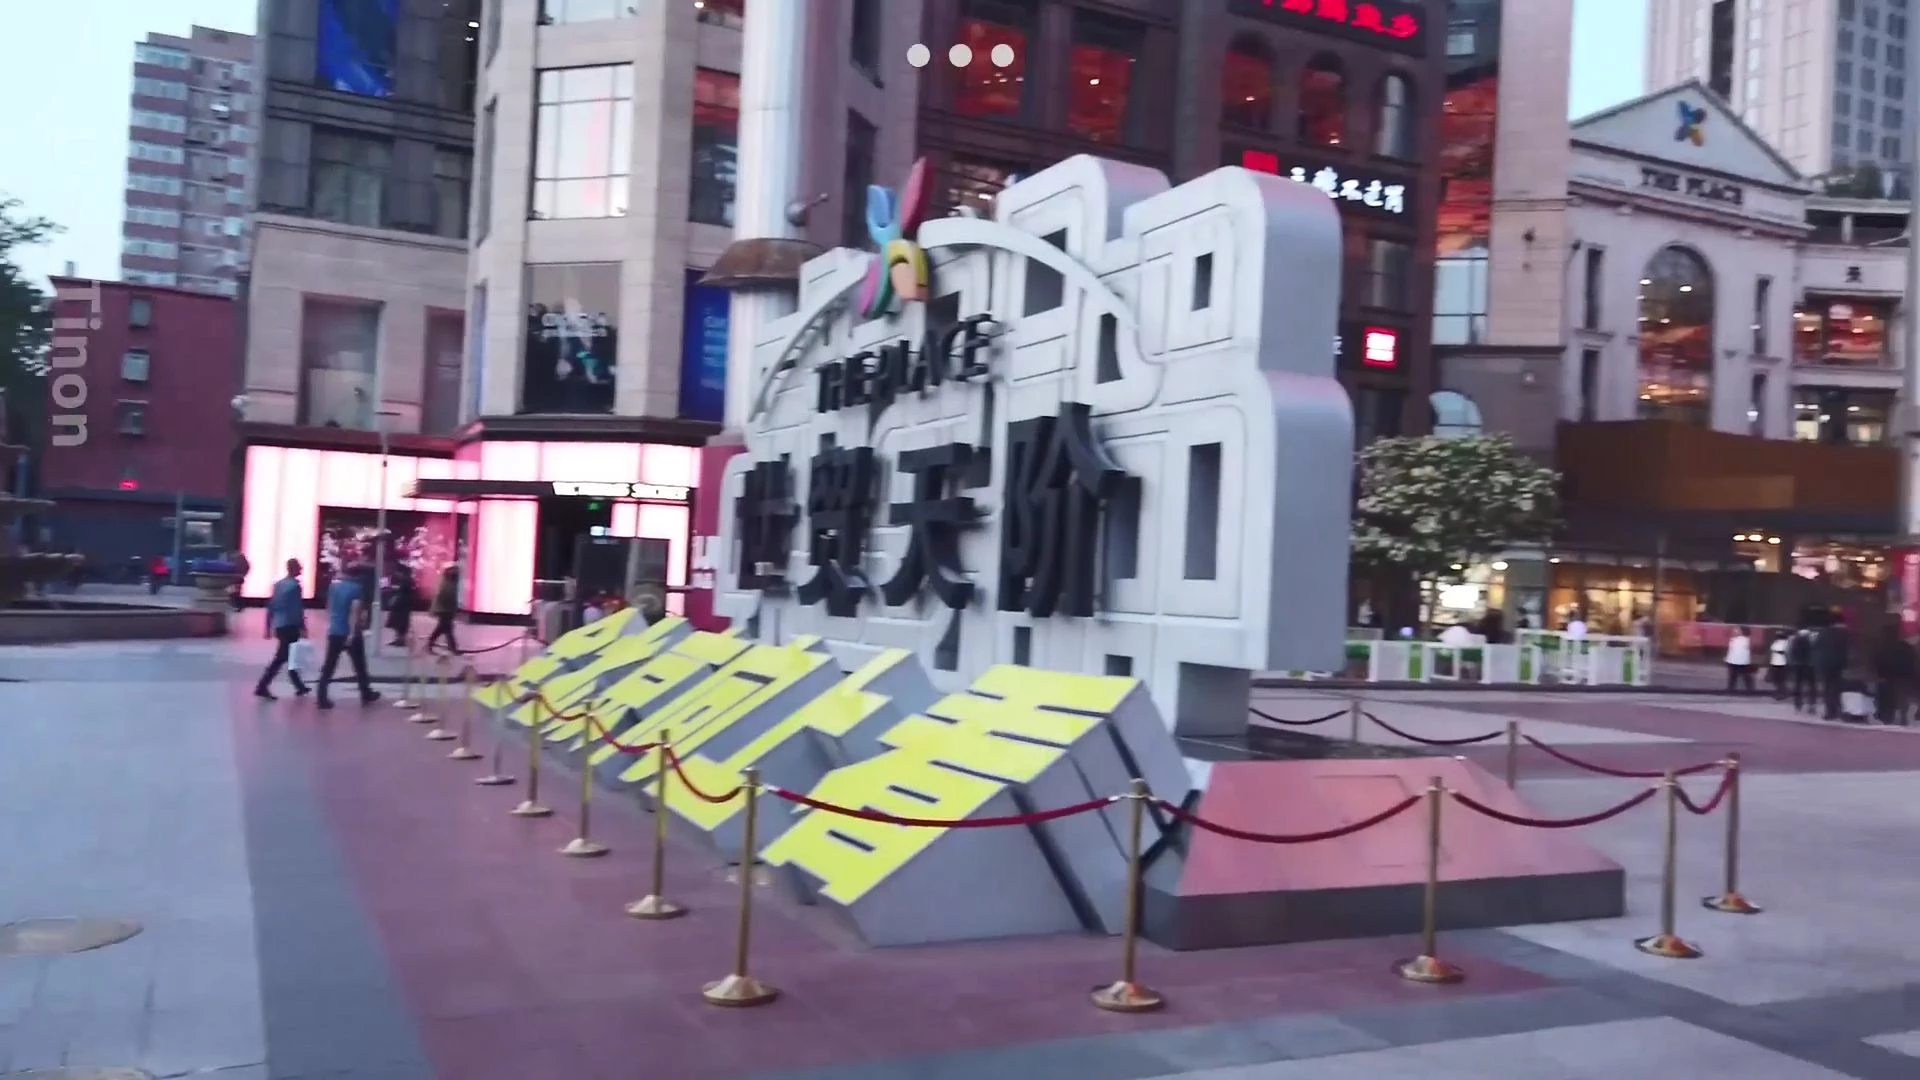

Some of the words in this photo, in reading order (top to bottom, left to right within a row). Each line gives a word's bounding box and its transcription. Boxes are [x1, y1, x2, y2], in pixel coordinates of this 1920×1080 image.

[815, 351, 877, 414] THE
[876, 313, 992, 402] PLACE
[735, 402, 1128, 618] 世贸天阶
[473, 606, 1139, 905] 全北京向上看
